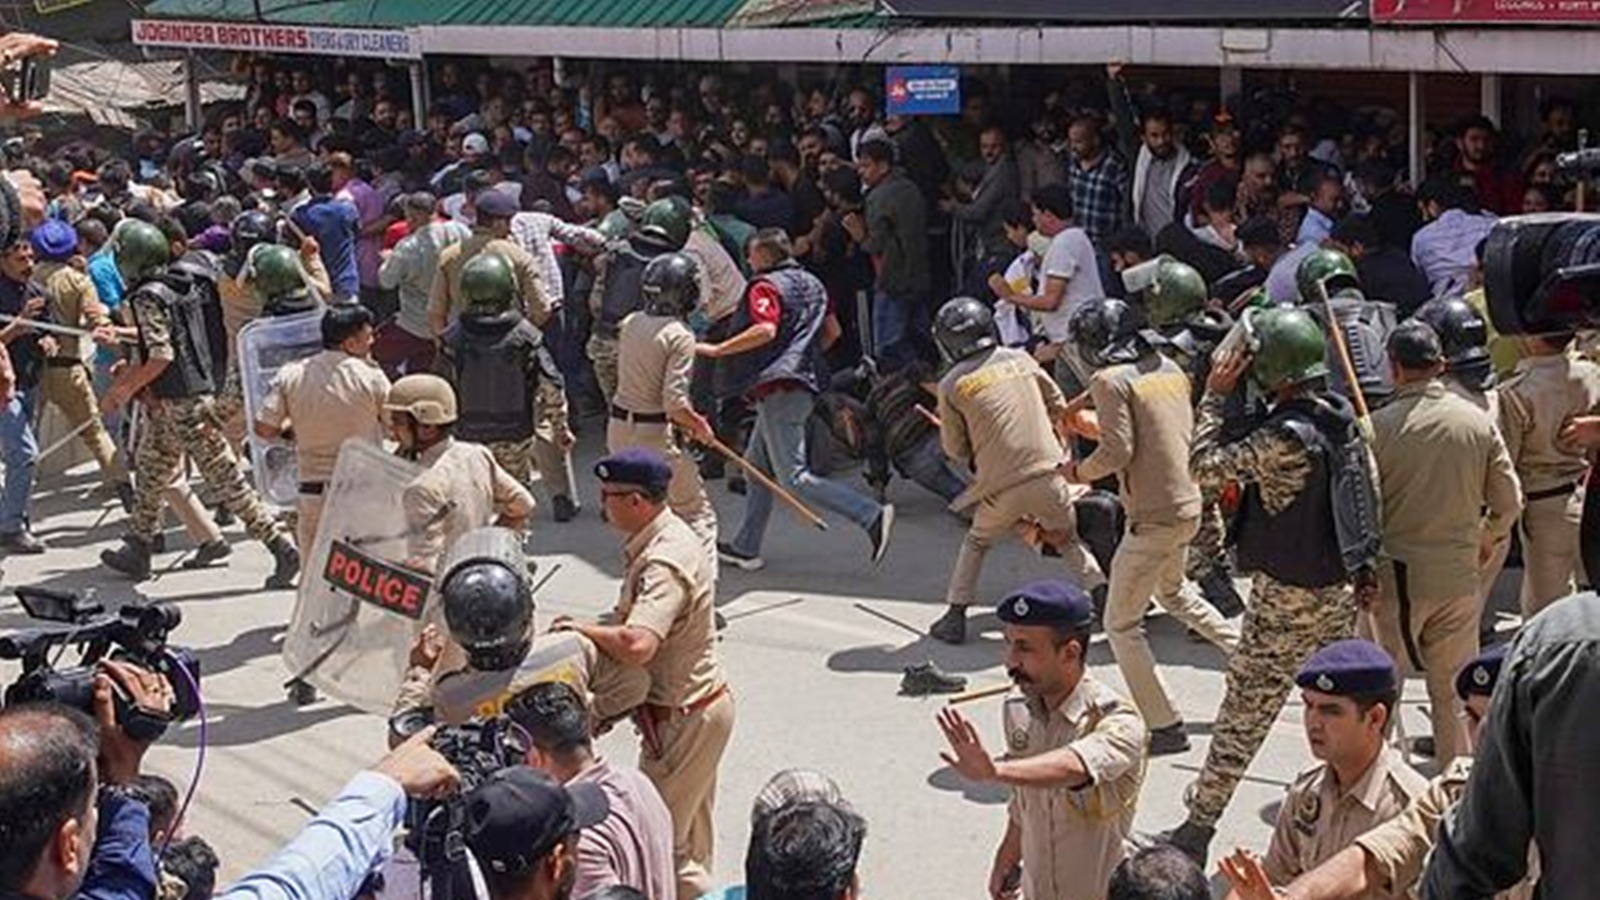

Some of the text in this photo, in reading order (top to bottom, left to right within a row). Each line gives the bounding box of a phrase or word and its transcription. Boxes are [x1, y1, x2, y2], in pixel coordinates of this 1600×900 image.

[136, 22, 215, 43] JOGINDER
[217, 26, 307, 48] BROTHERS
[328, 550, 422, 610] POLICE
